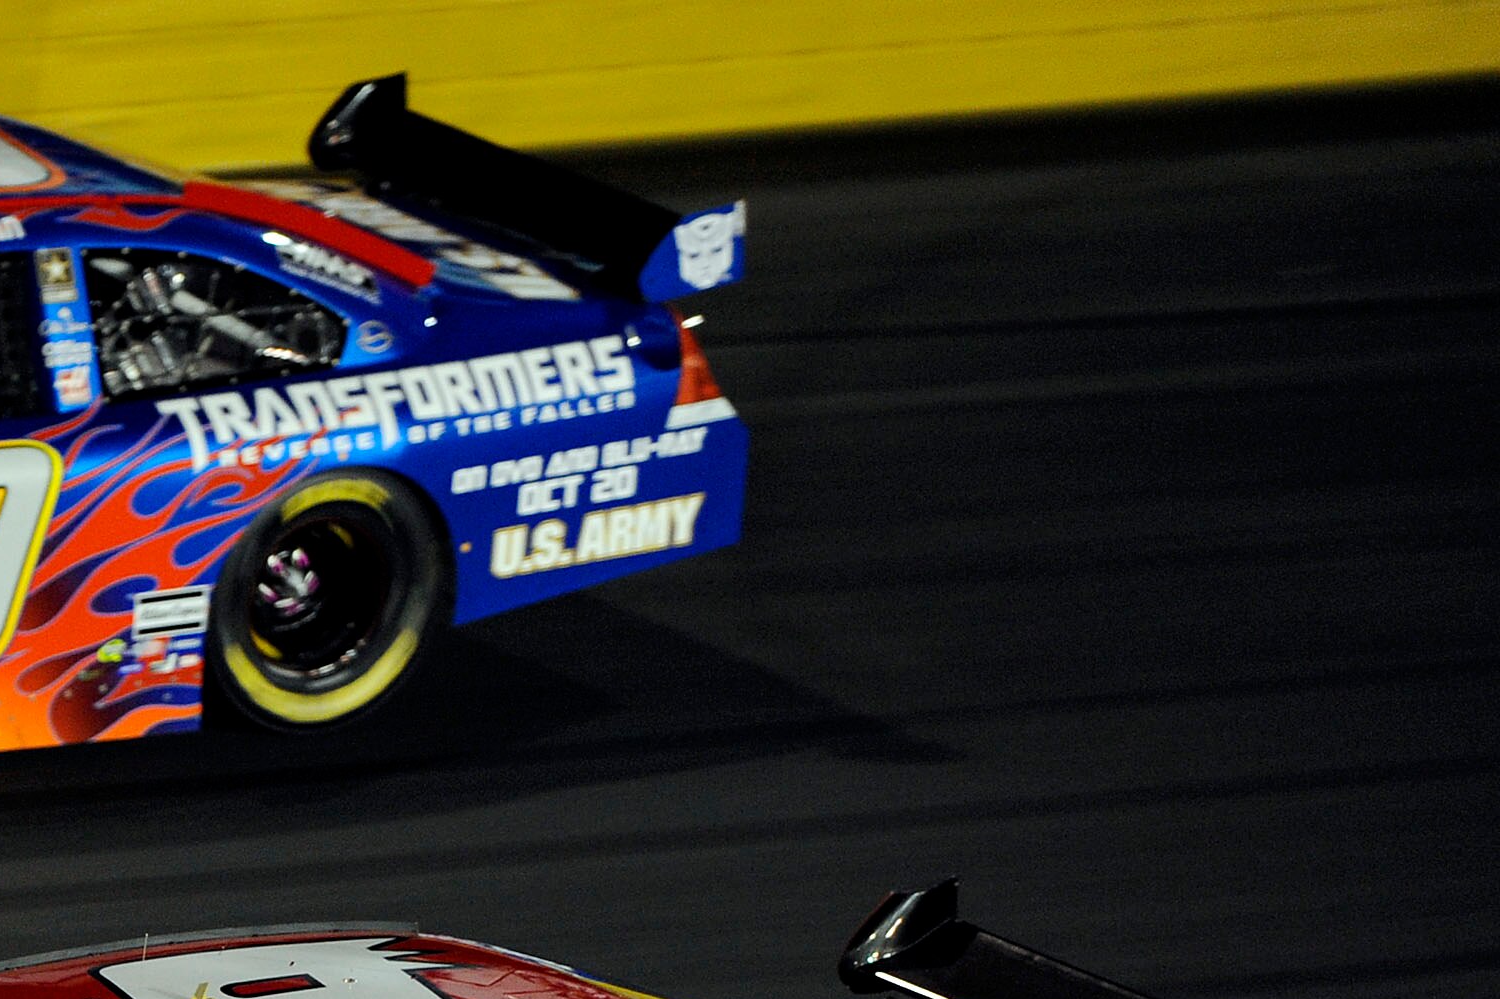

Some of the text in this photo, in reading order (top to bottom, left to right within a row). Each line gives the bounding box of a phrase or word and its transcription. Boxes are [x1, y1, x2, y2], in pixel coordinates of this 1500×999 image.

[157, 334, 635, 474] TRANSFORMERS
[406, 422, 446, 444] OF
[453, 411, 513, 437] THE
[520, 390, 635, 425] FALLEN
[516, 464, 639, 517] OCT 20
[489, 490, 706, 580] U.S. ARMY
